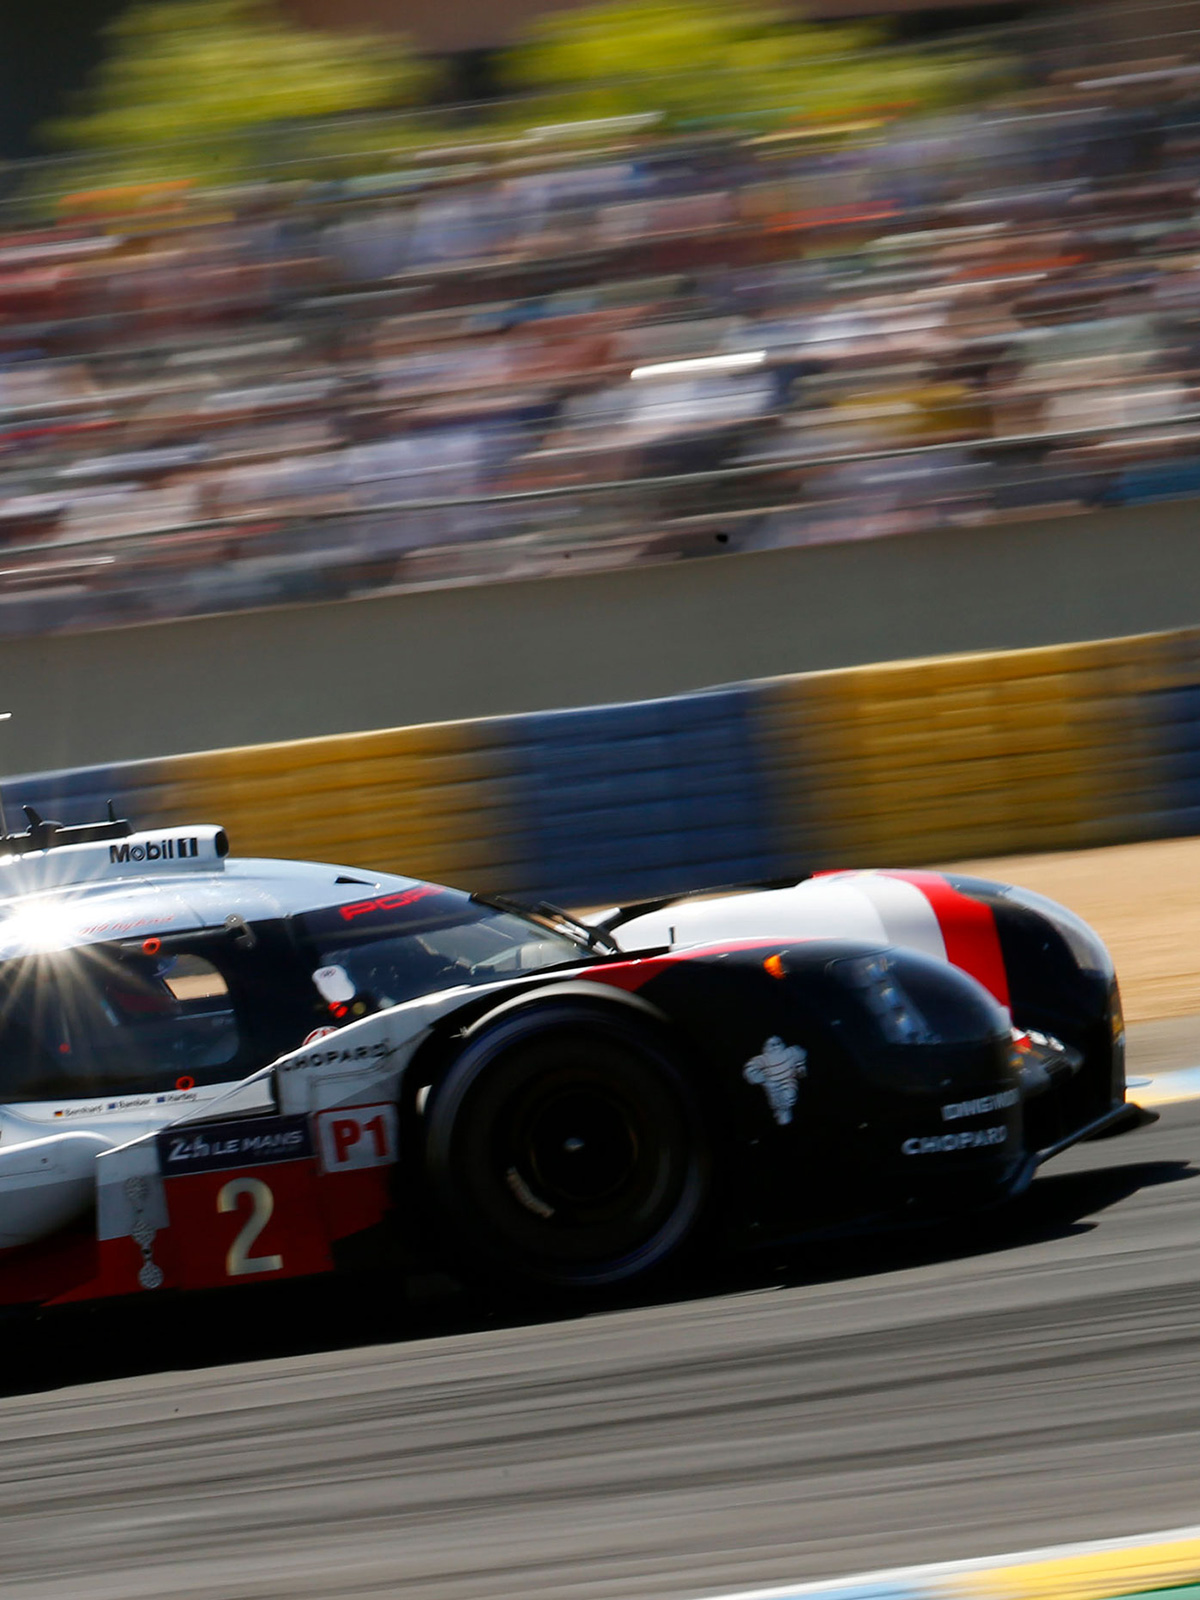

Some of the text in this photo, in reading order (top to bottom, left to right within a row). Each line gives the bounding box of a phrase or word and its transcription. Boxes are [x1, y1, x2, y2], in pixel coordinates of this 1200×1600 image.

[109, 838, 198, 864] Mobil 1
[281, 1042, 389, 1072] CHOPARD
[211, 1138, 241, 1156] LE
[241, 1129, 304, 1152] MANS
[331, 1113, 389, 1164] P1
[901, 1125, 1008, 1155] CHOPARD
[216, 1176, 284, 1276] 2
